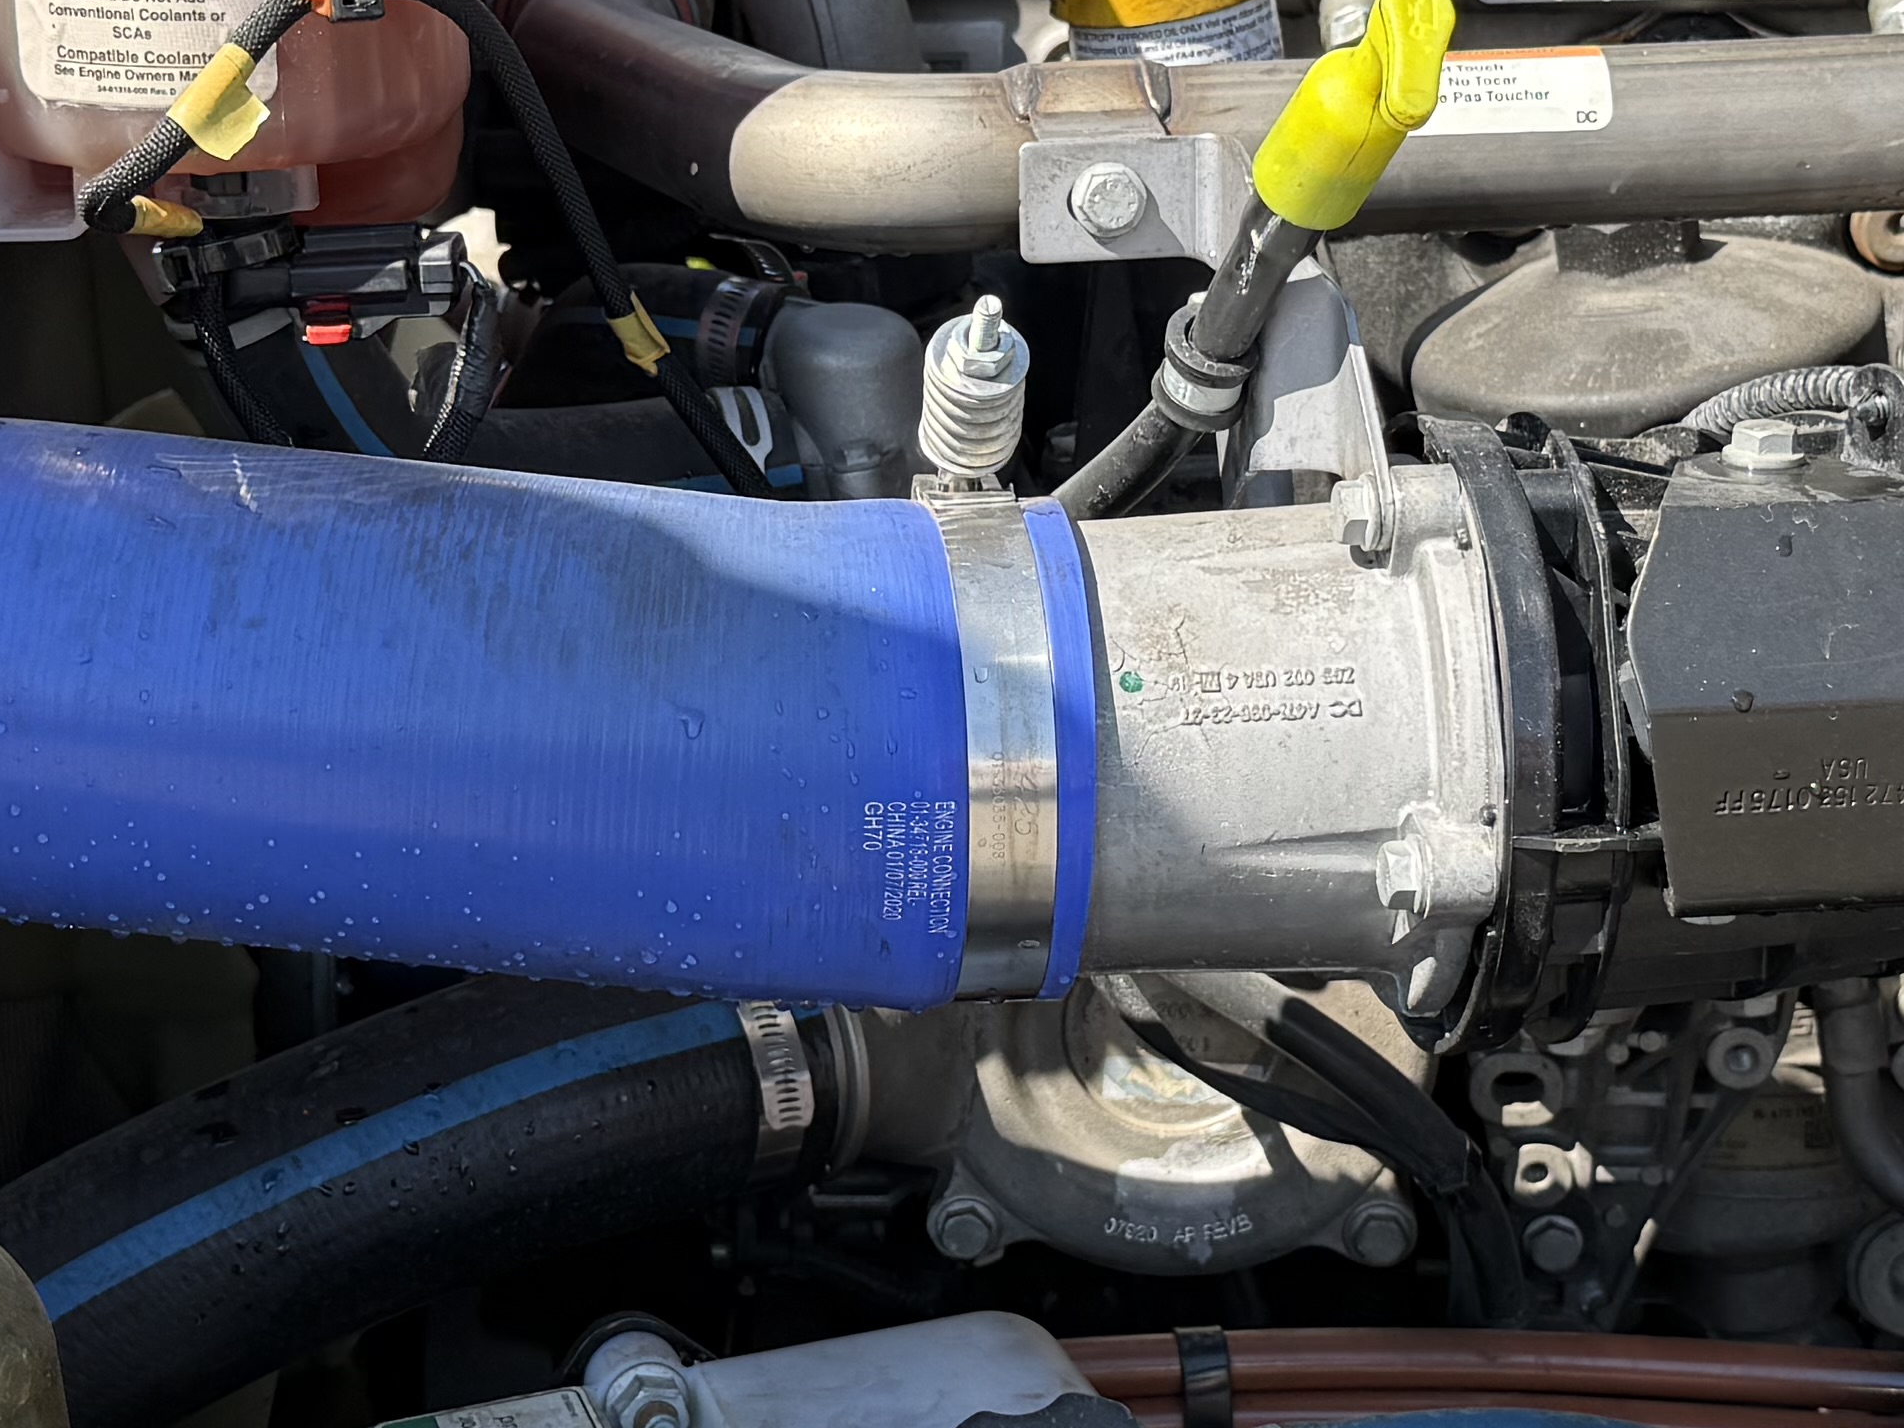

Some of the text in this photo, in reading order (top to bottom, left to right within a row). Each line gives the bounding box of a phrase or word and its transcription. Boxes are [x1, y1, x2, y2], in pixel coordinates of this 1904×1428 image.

[48, 3, 226, 22] Conventional Coolants or
[112, 26, 152, 39] SCAs
[1180, 23, 1204, 36] ONLY
[56, 45, 139, 64] Compatible
[54, 64, 175, 82] See Engine Owners
[1448, 76, 1517, 87] No Tocar
[1453, 89, 1550, 103] Pas Toucher
[1576, 110, 1598, 123] DC
[1329, 699, 1363, 718] DC
[1821, 758, 1868, 781] USA
[863, 801, 884, 851] GH70
[883, 801, 906, 920] CHINA 01/07/2020
[928, 801, 956, 934] ENGINE CONNECTION
